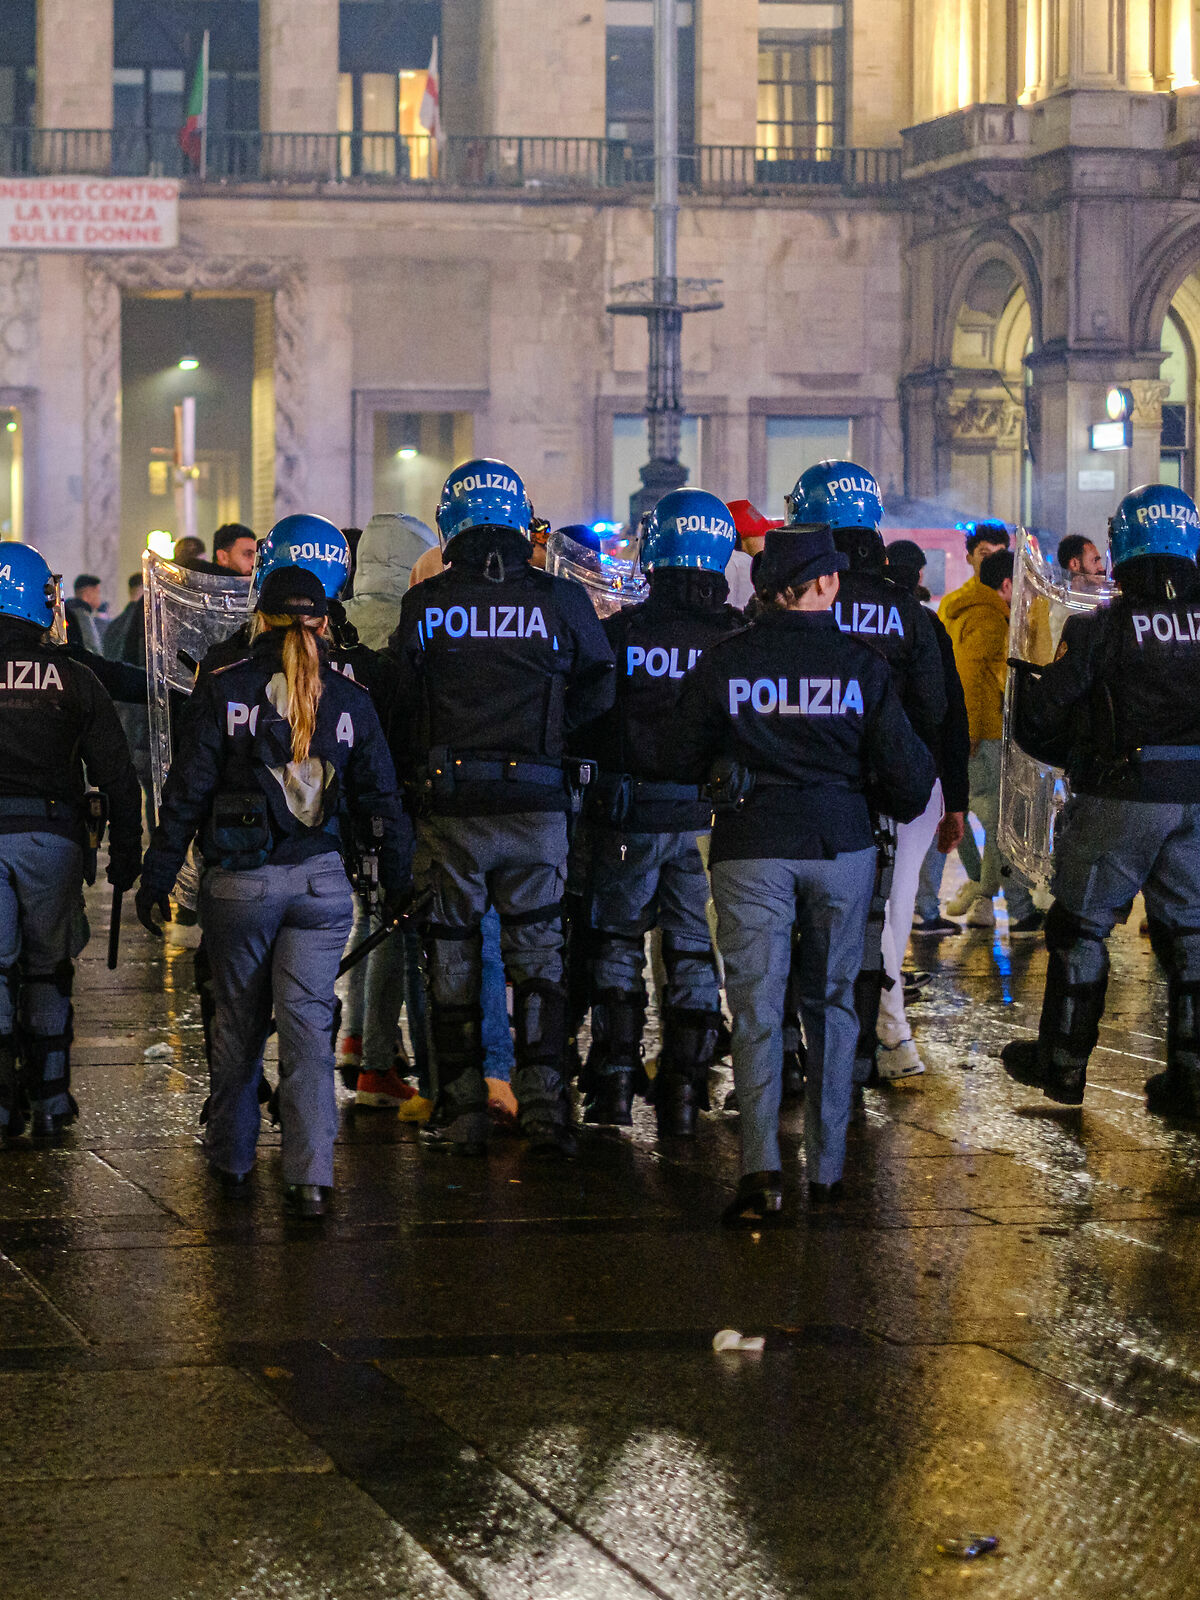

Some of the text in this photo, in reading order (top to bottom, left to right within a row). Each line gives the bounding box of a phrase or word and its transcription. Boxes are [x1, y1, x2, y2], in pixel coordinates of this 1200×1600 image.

[85, 183, 177, 200] CONTRO
[15, 205, 156, 221] LA VIOLENZA
[9, 226, 161, 242] SULLE DONNE
[453, 474, 518, 497] POLIZIA
[1136, 504, 1198, 528] POLIZIA
[677, 516, 734, 542] POLIZIA
[424, 605, 548, 639] POLIZIA
[827, 602, 904, 636] LIZIA
[626, 646, 703, 678] POLI
[728, 678, 864, 715] POLIZIA
